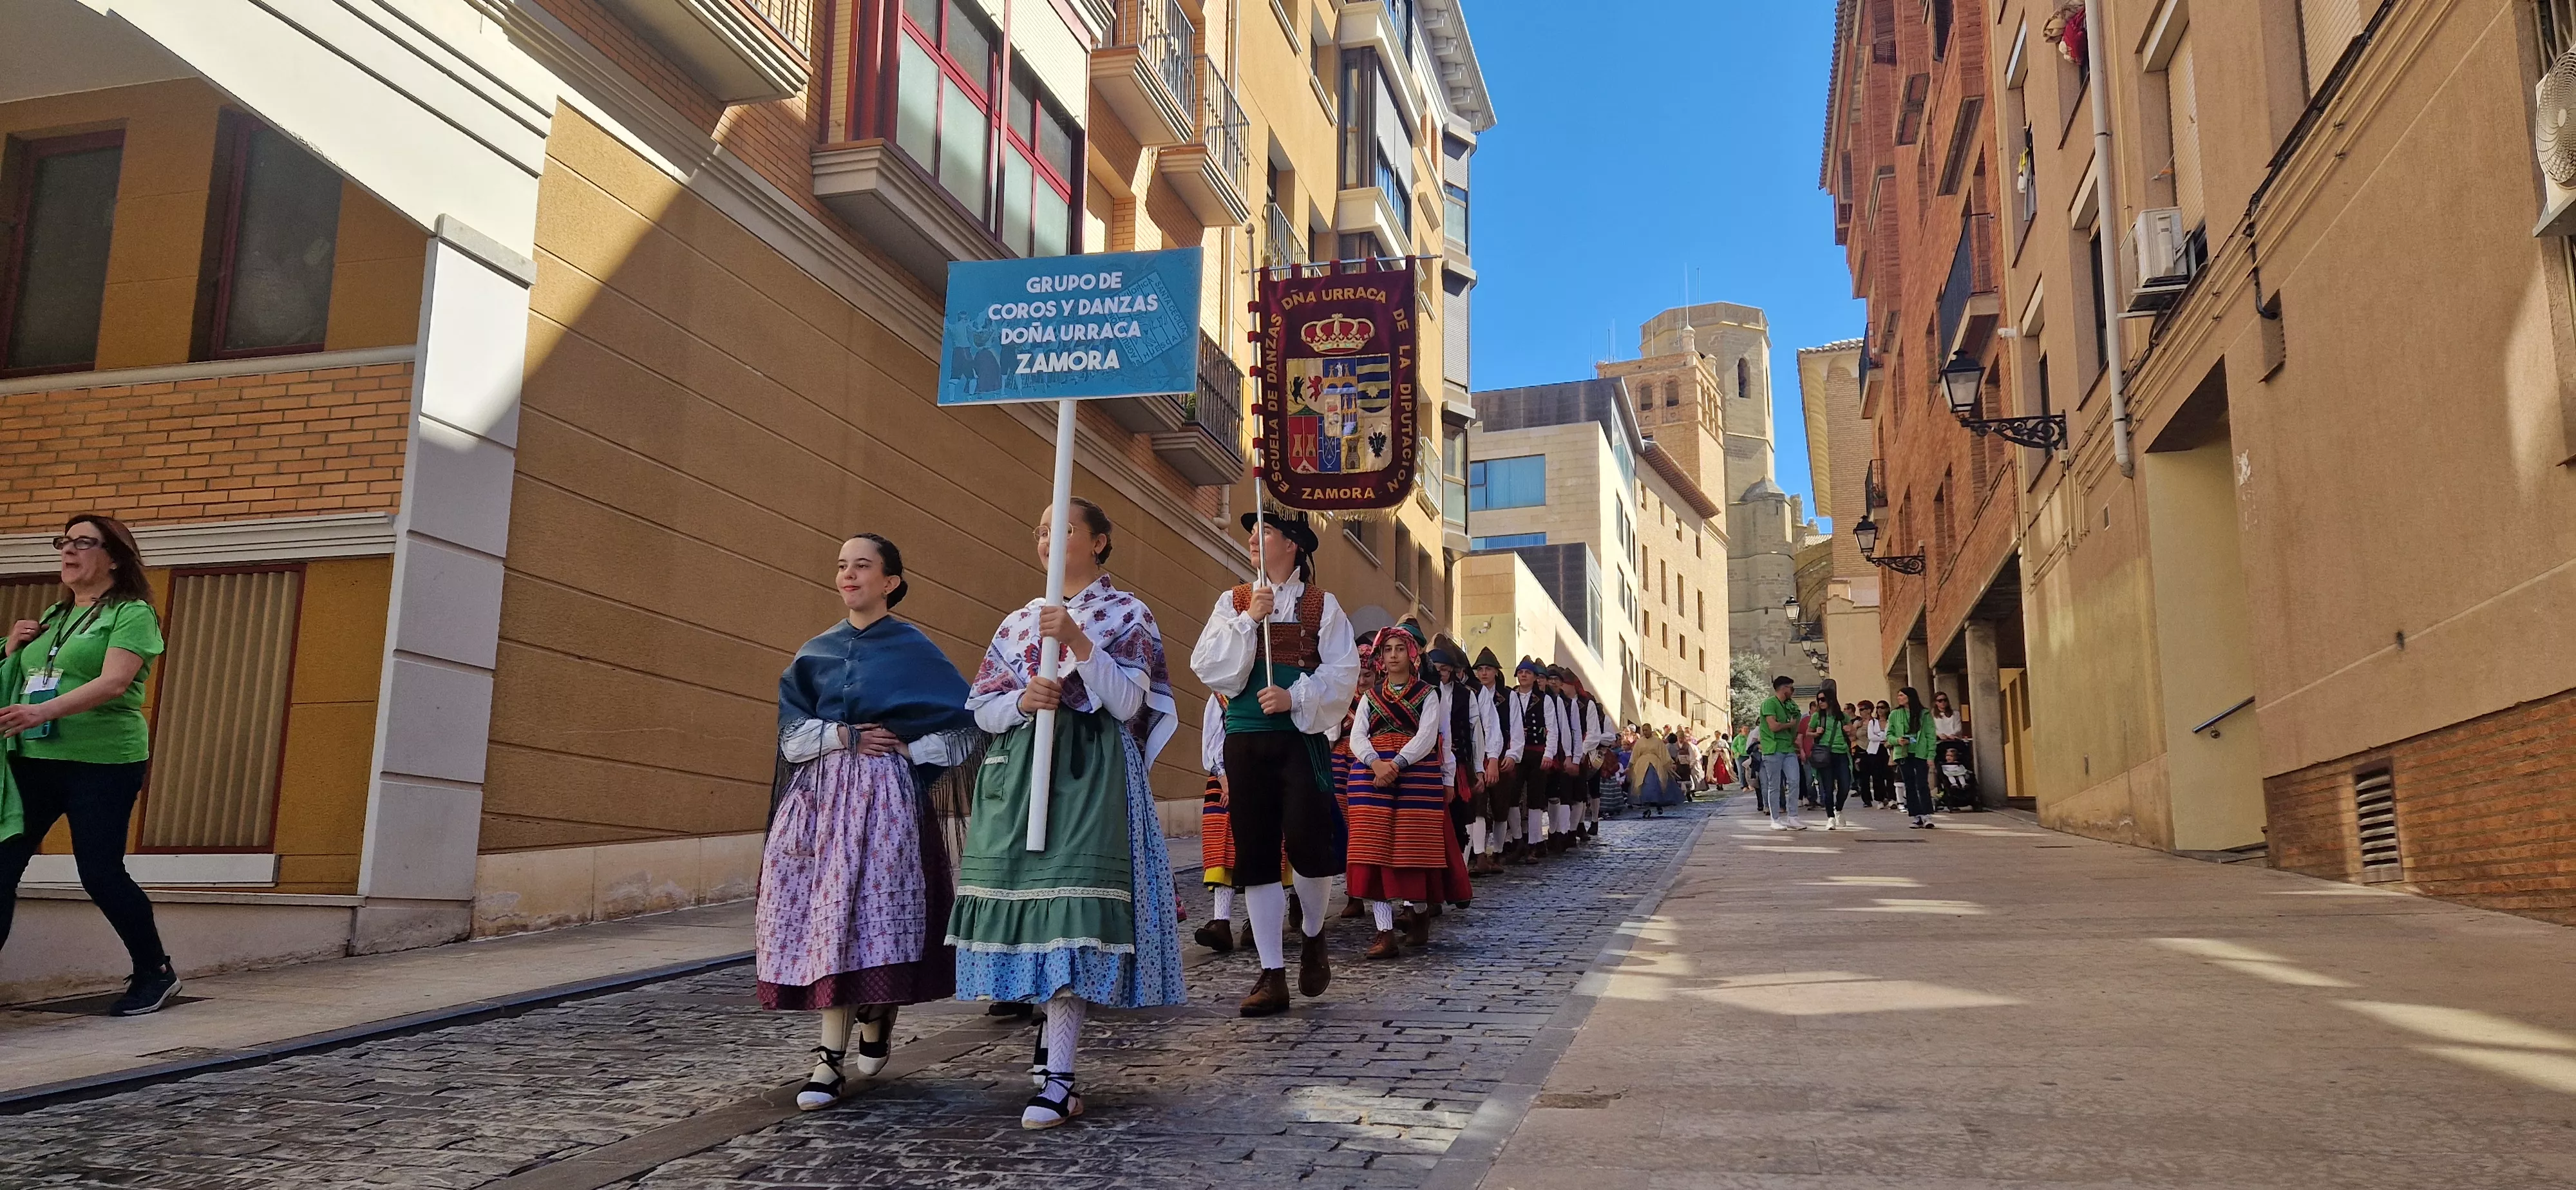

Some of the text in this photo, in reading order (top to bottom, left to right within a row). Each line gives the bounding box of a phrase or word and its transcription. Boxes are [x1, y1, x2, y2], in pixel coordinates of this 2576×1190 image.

[1027, 272, 1122, 293] GRUPO DE
[989, 294, 1158, 321] COROS Y DANZAS
[1155, 281, 1188, 334] SANTA CECILIA
[1281, 287, 1386, 310] DÑA URRACA
[1001, 321, 1141, 345] DOÑA URRACA
[1144, 335, 1179, 359] HUESCA
[1015, 349, 1120, 375] ZAMORA
[1265, 313, 1289, 493] ESCUELA DE DANZAS
[1387, 308, 1412, 493] DE LA DIPUTACION
[1302, 487, 1376, 500] ZAMORA
